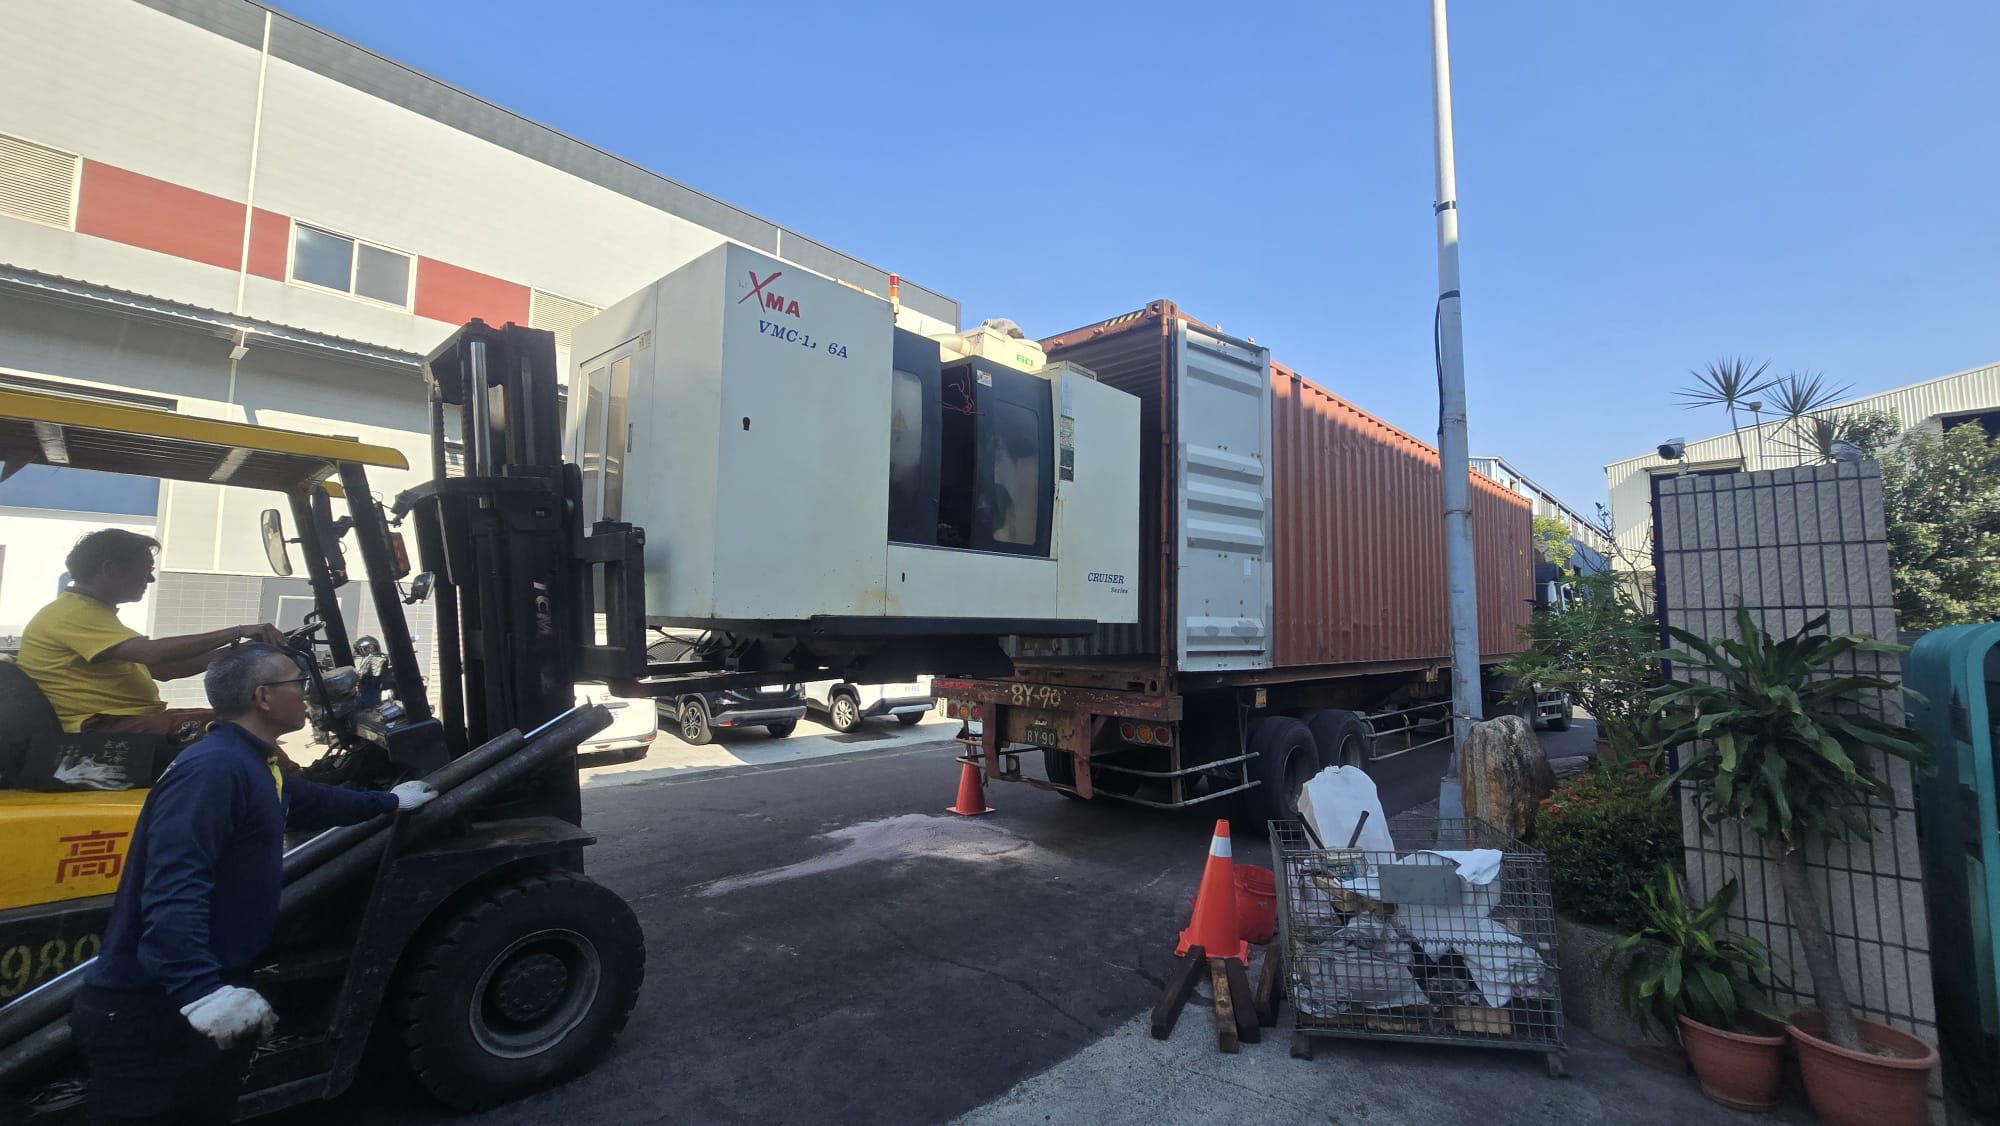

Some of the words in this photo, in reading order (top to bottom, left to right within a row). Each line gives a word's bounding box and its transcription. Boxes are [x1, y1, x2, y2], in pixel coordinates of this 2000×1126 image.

[1087, 572, 1125, 584] CRUISER
[1110, 586, 1128, 594] Series
[55, 830, 128, 884] 高
